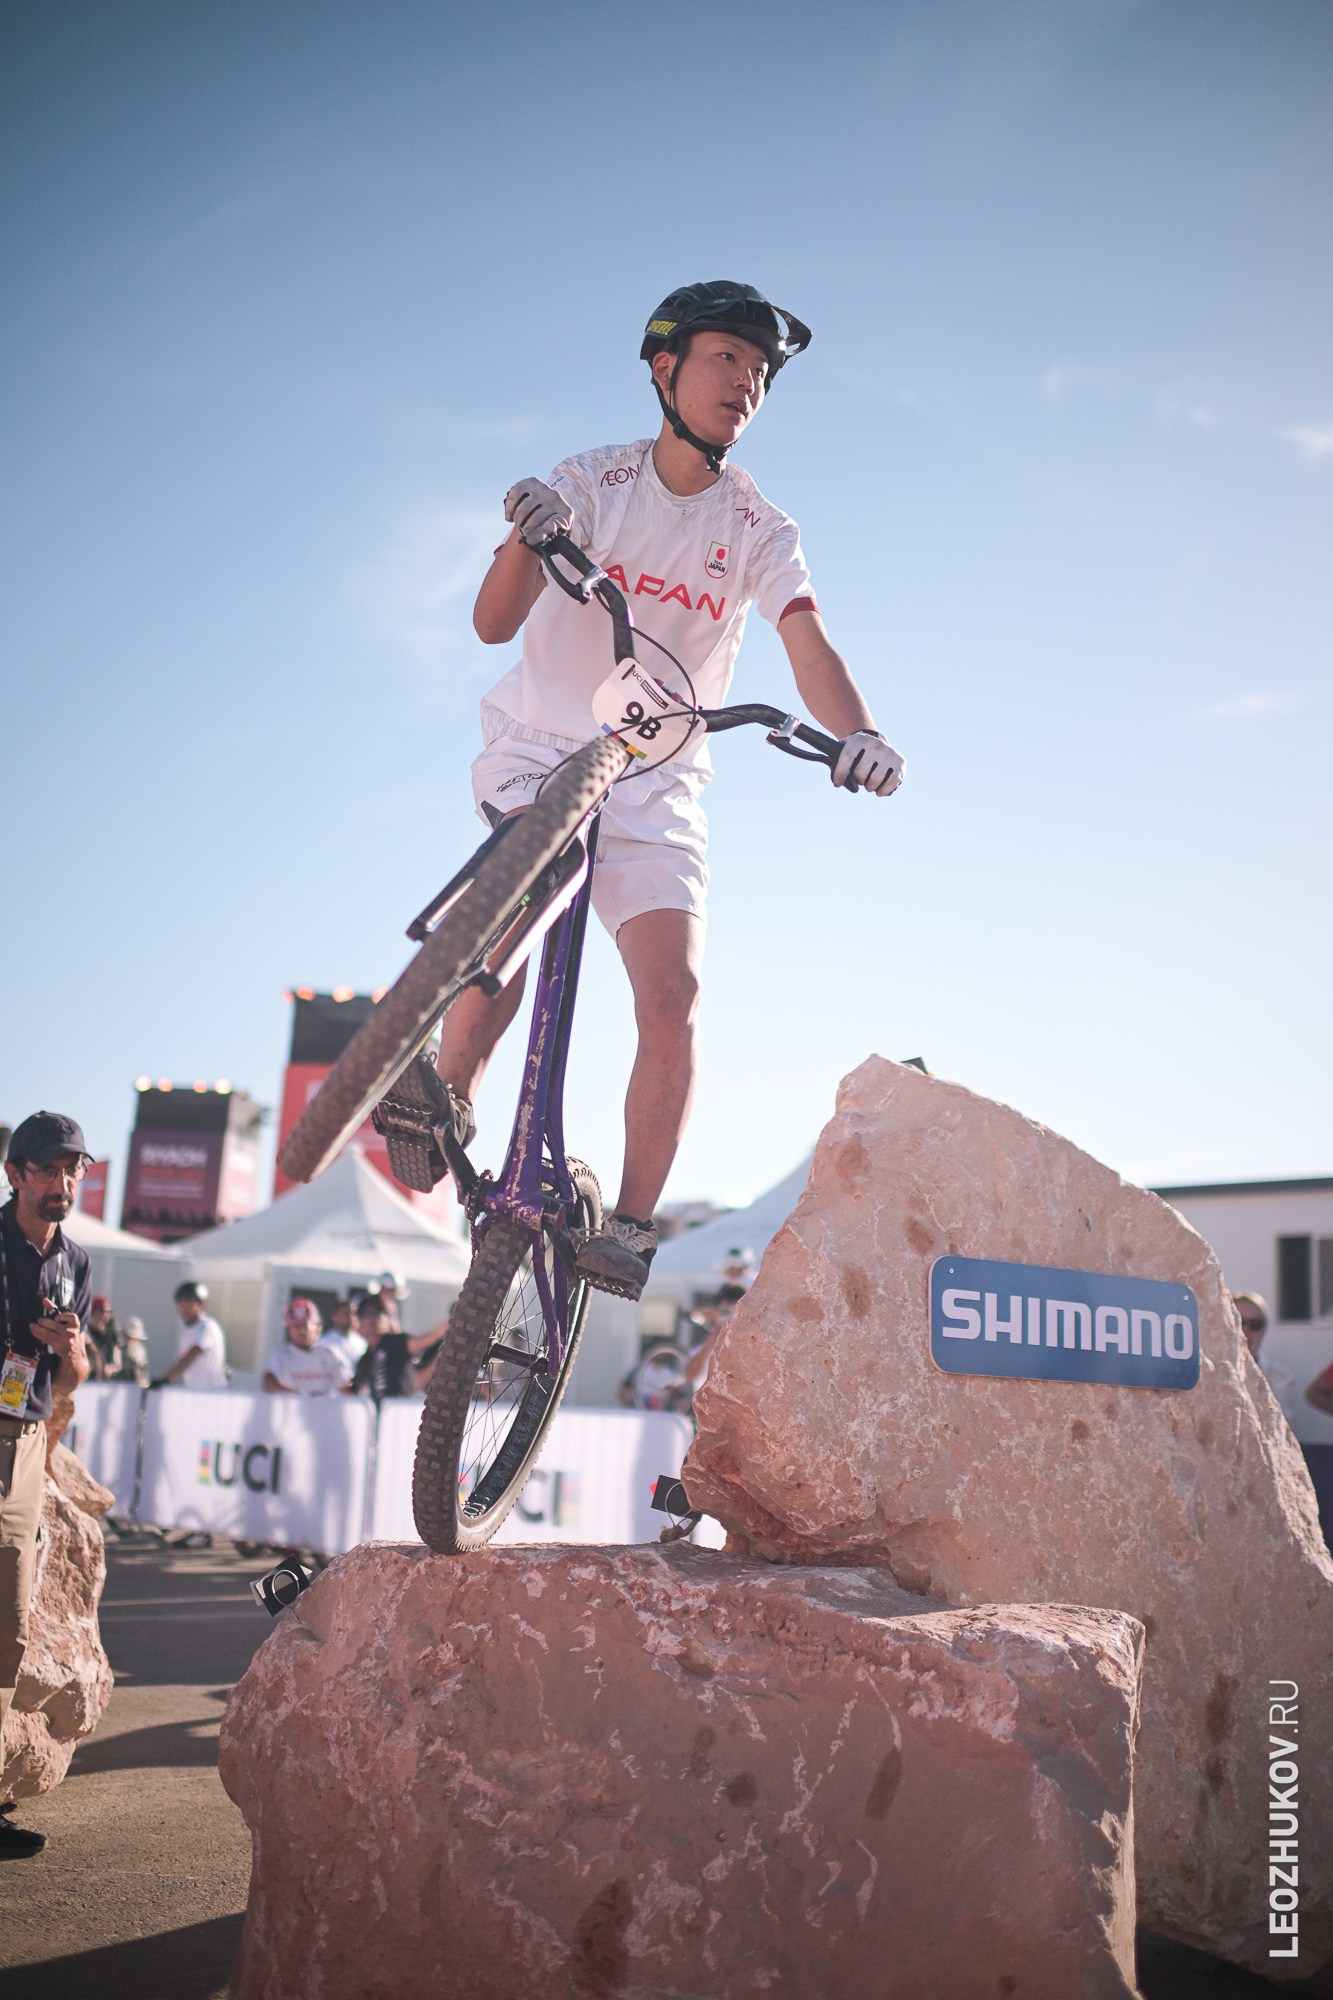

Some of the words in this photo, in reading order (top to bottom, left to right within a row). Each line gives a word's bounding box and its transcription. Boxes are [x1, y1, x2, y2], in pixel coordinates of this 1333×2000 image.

[708, 563, 726, 573] JAPAN
[602, 564, 726, 621] APAN
[632, 670, 644, 683] UCI
[620, 701, 662, 741] 9B
[941, 1288, 1194, 1360] SHIMANO
[214, 1441, 281, 1495] UCI
